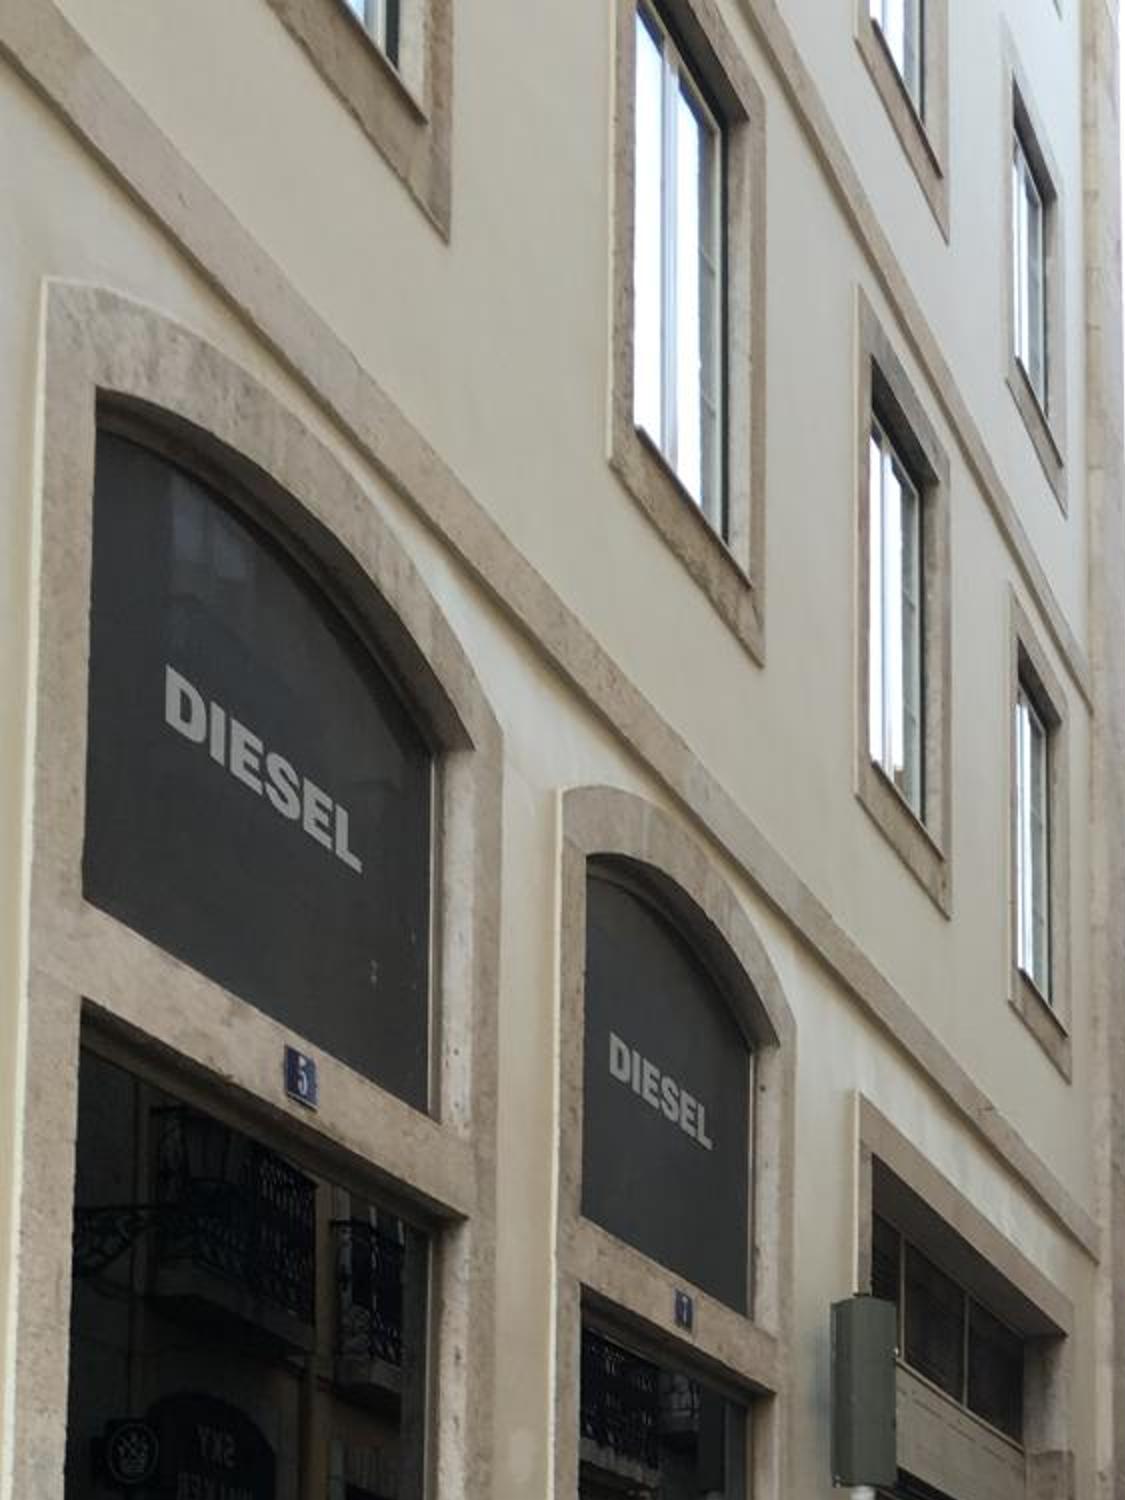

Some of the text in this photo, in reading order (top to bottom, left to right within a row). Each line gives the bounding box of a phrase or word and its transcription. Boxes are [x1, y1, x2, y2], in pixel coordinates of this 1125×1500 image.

[164, 663, 363, 874] DIESEL
[297, 1055, 308, 1097] 5
[608, 1031, 713, 1151] DIESEL
